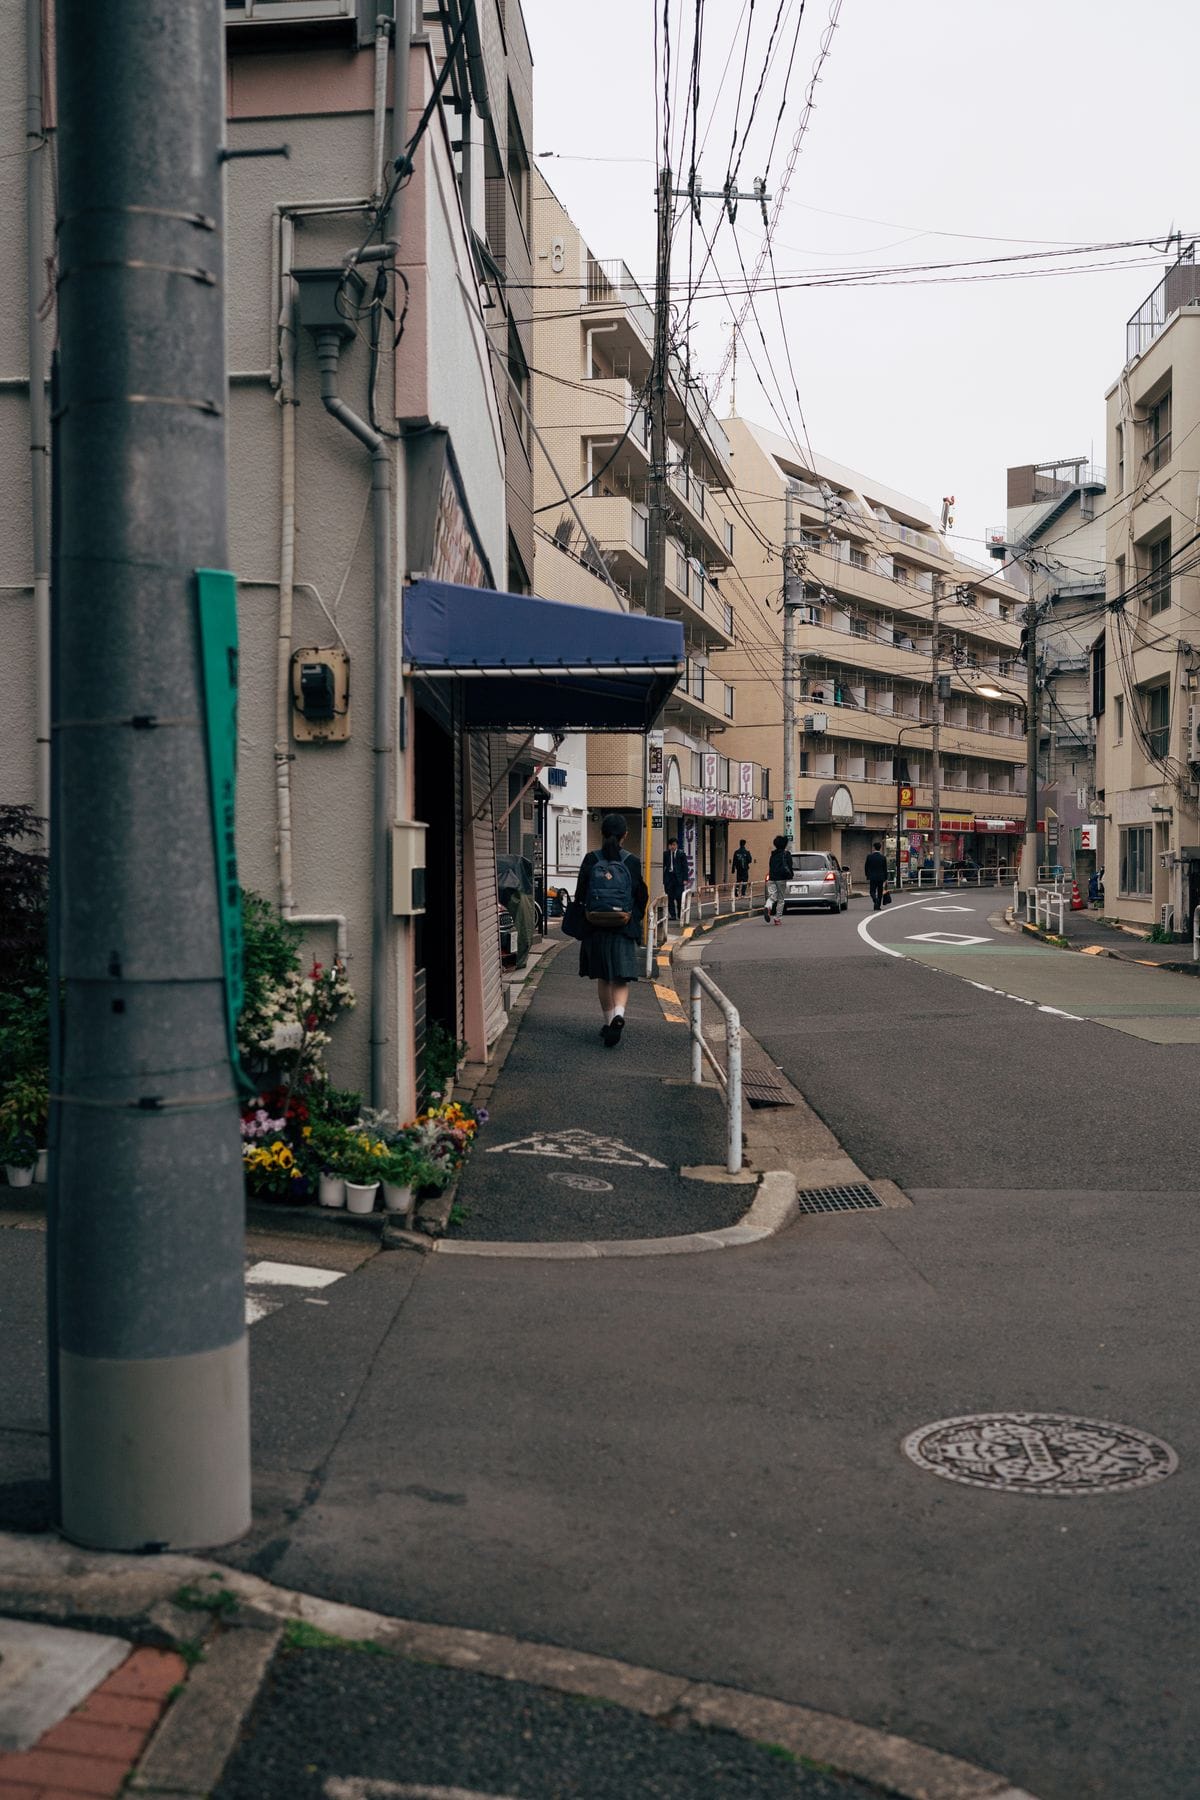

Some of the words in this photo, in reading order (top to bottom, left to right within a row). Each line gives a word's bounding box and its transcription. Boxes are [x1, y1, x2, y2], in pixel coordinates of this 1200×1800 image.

[742, 764, 752, 818] クリーング
